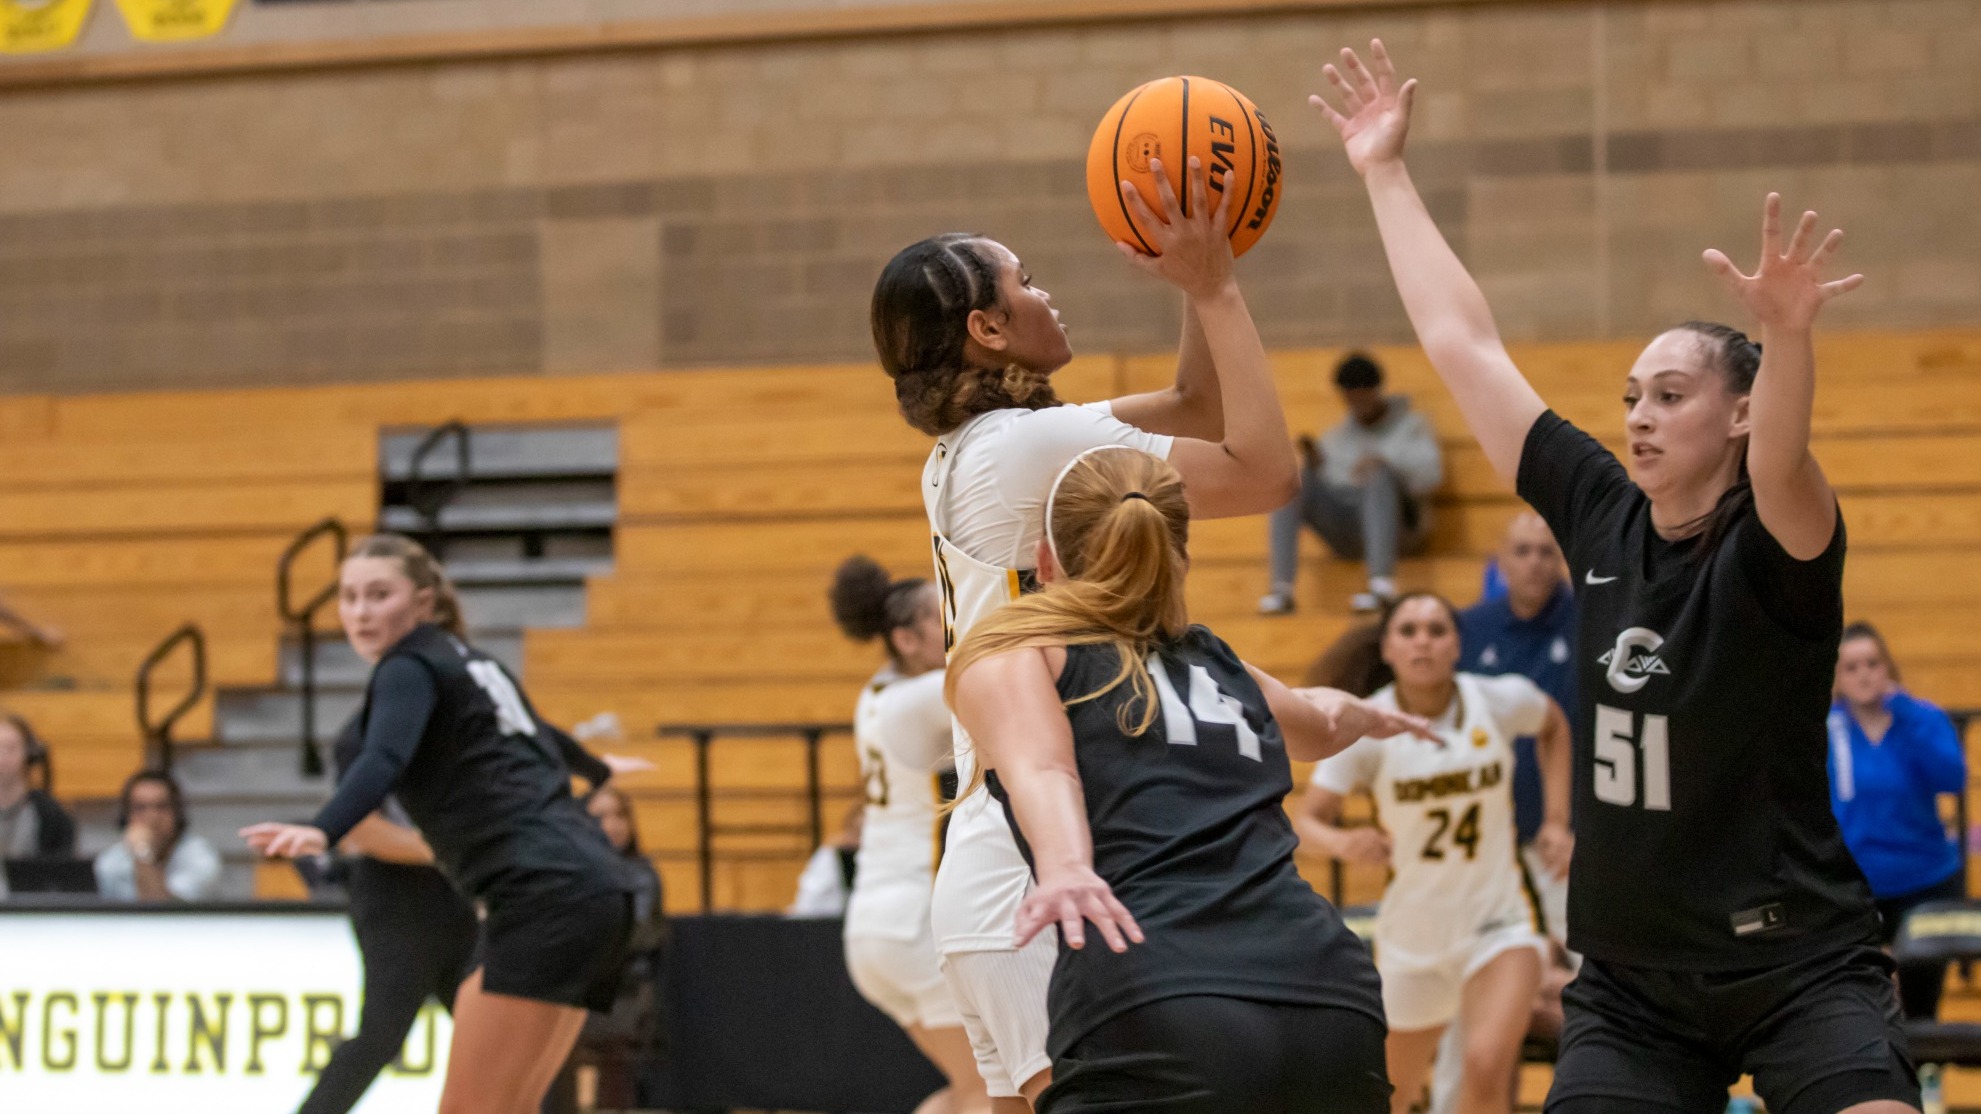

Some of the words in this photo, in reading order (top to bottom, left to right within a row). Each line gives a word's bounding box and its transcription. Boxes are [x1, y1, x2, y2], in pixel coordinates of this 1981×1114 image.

[1147, 651, 1263, 763] 14
[1594, 703, 1671, 811] 51
[1422, 803, 1480, 862] 24
